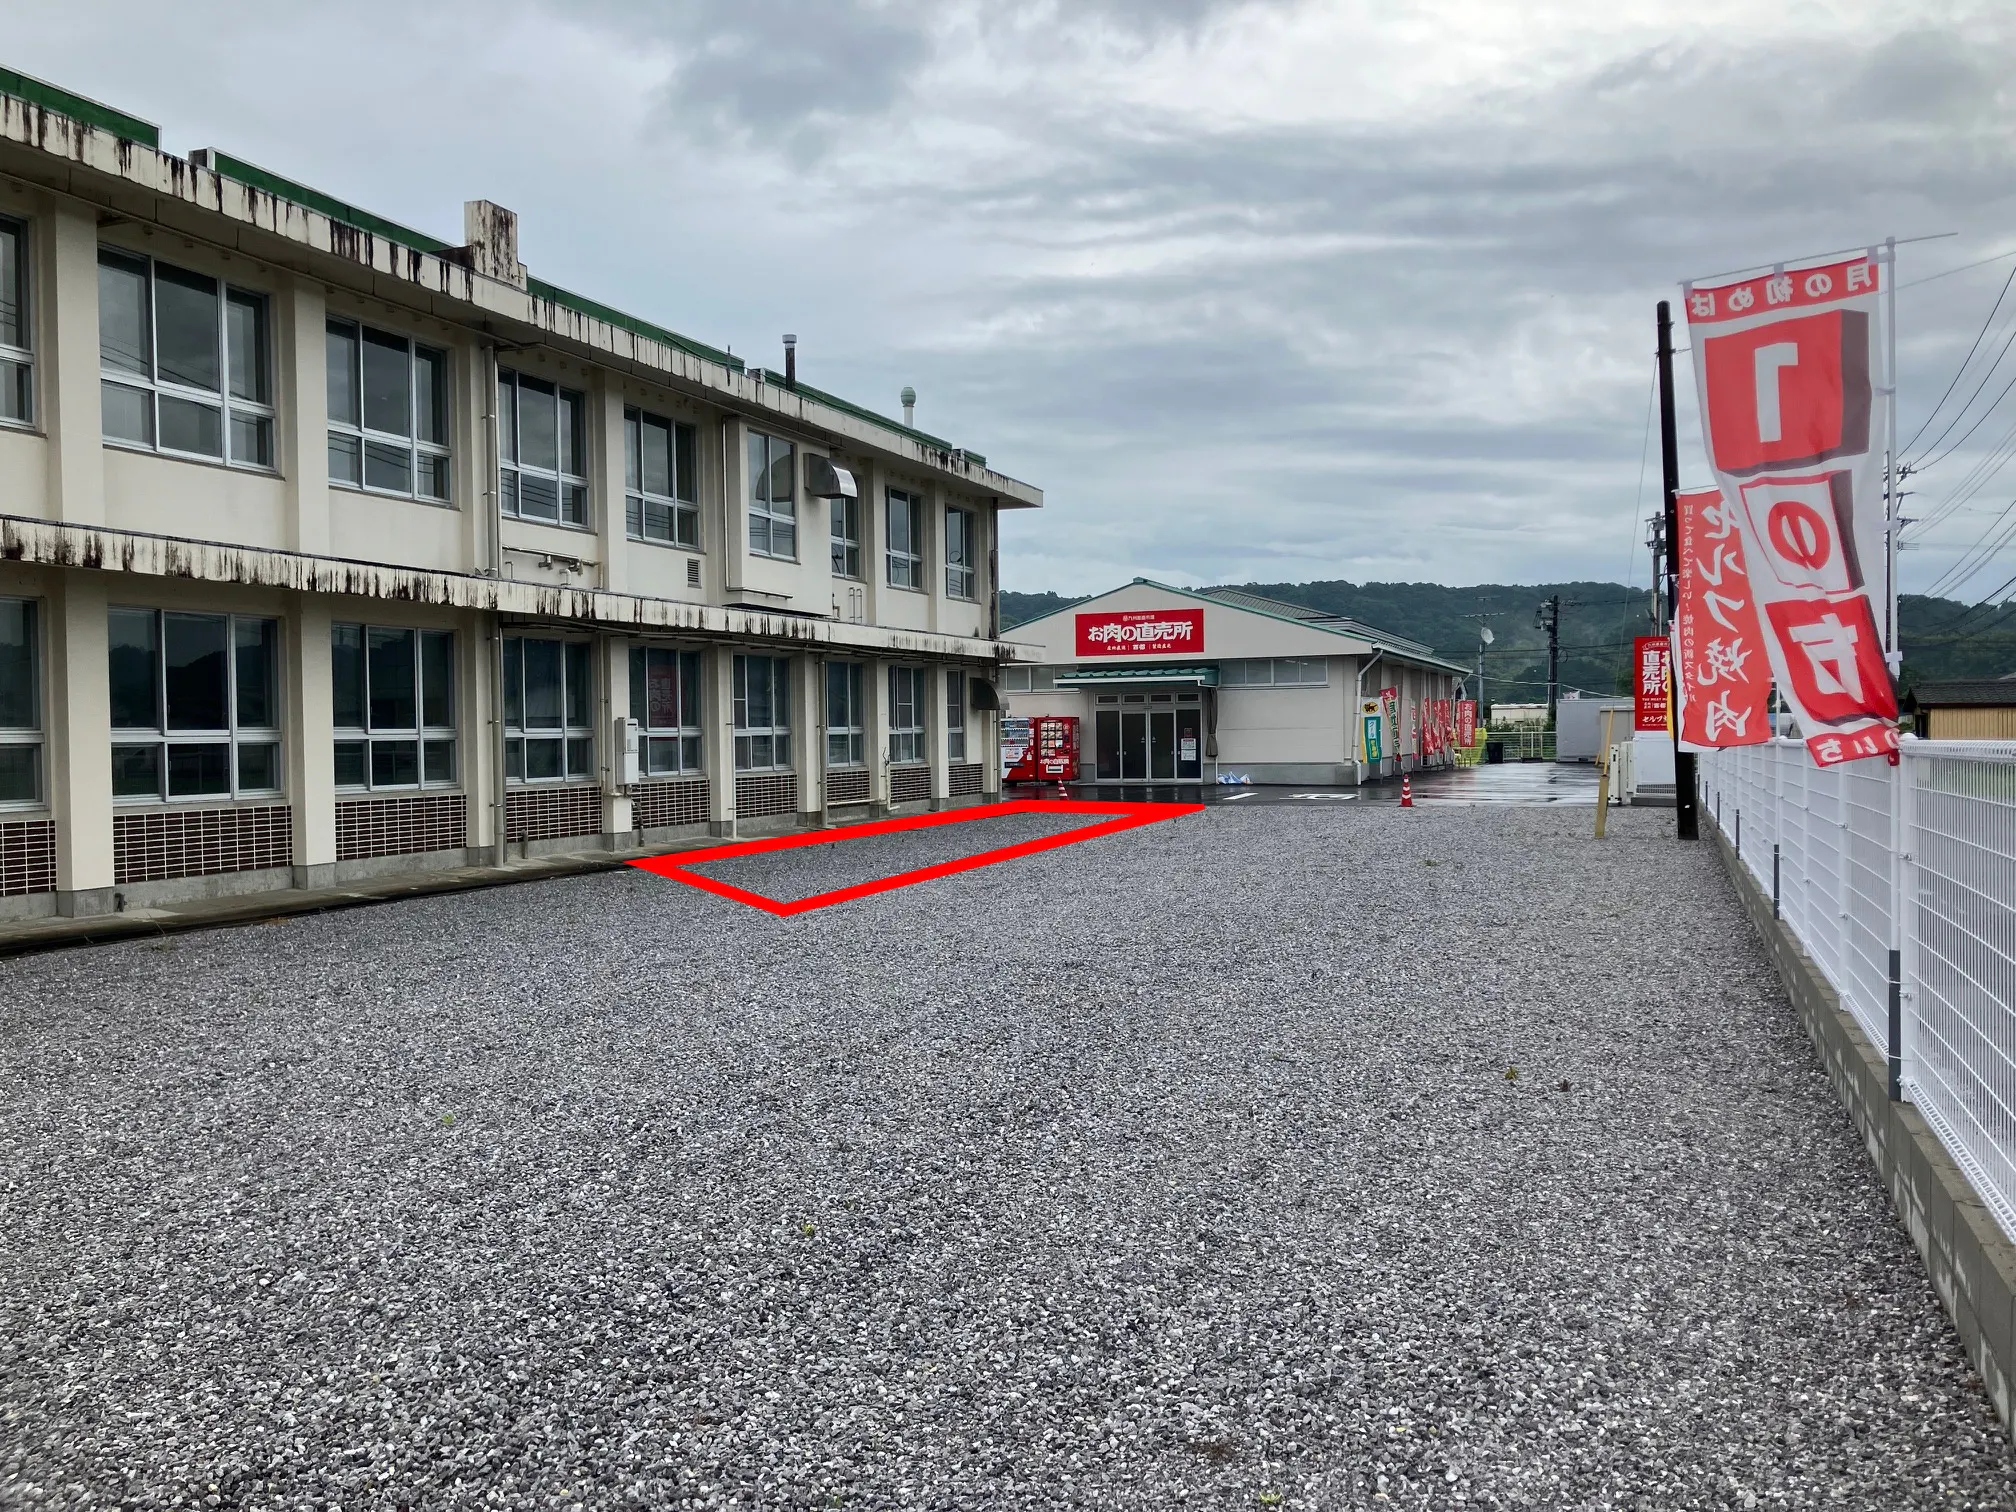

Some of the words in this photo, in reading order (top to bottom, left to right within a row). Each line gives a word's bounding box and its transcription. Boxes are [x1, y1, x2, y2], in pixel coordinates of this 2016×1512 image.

[1088, 621, 1193, 643] お肉の直売所
[1642, 650, 1661, 696] 直売所
